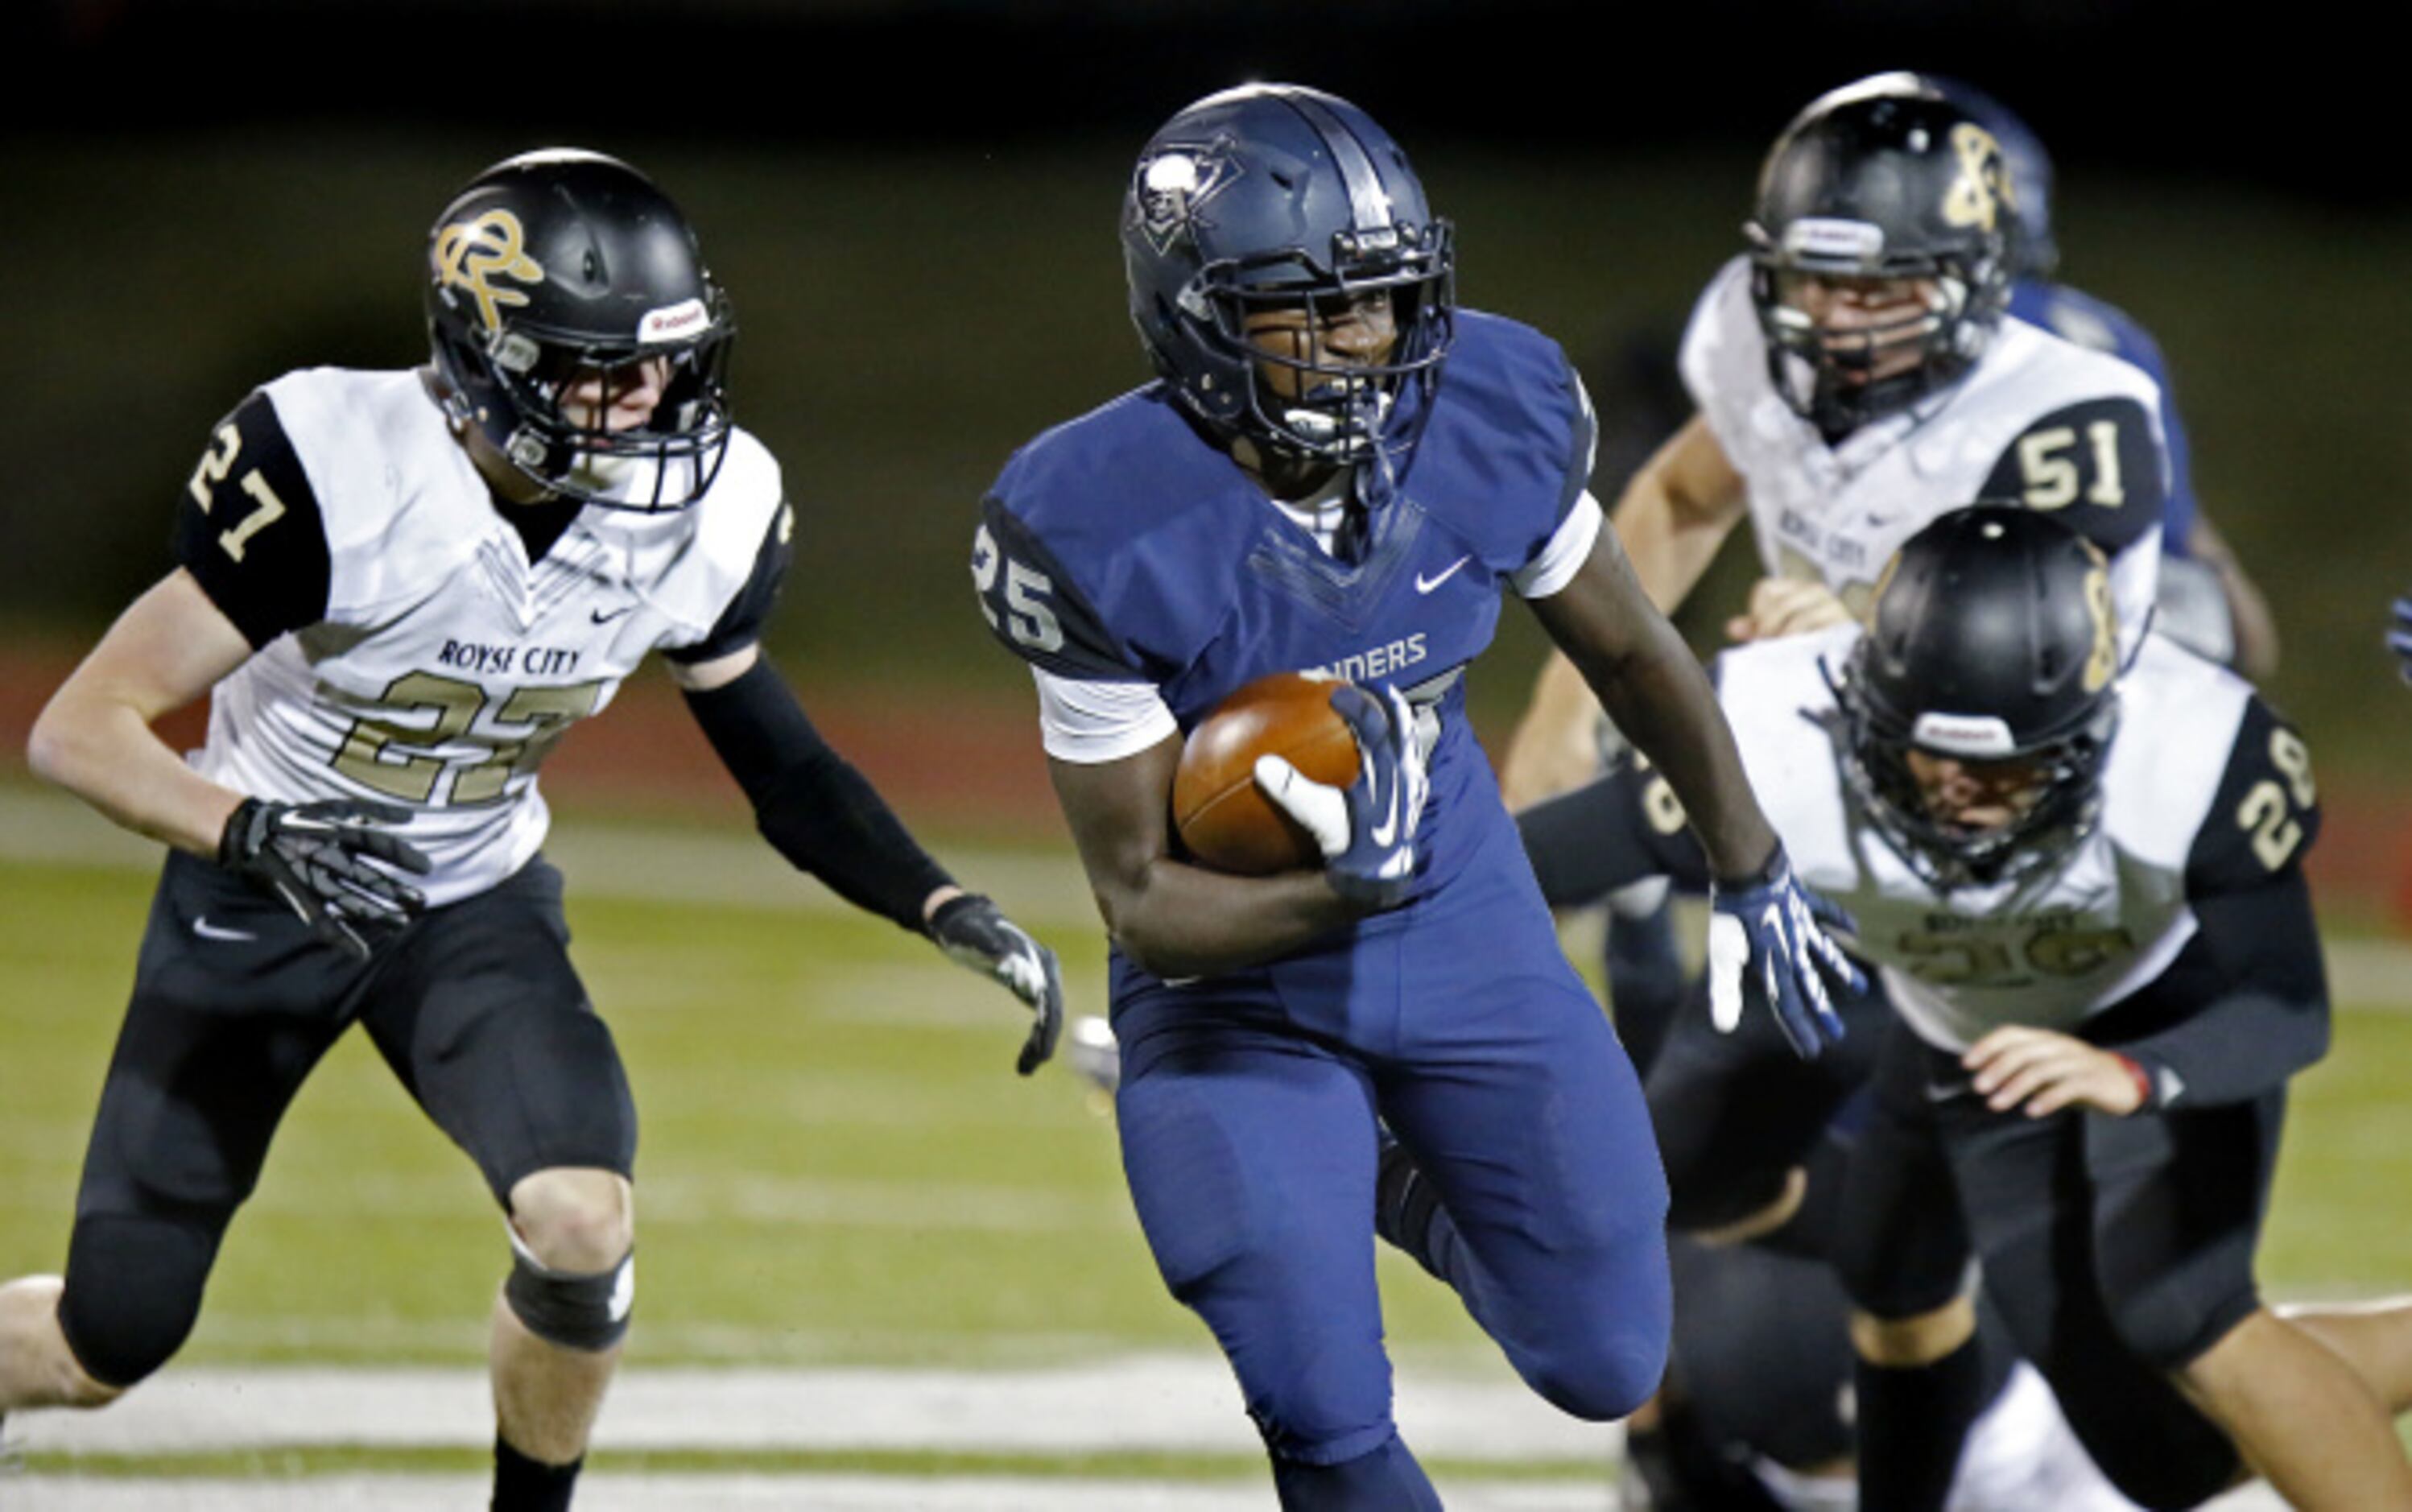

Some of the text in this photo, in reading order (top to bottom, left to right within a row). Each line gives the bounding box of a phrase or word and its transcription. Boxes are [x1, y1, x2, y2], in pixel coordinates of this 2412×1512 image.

[189, 423, 286, 563] 27
[2018, 420, 2125, 511] 51
[970, 523, 1064, 652] 25
[439, 639, 583, 675] ROYSE CITY
[328, 669, 602, 804] 27
[2237, 726, 2316, 872] 28
